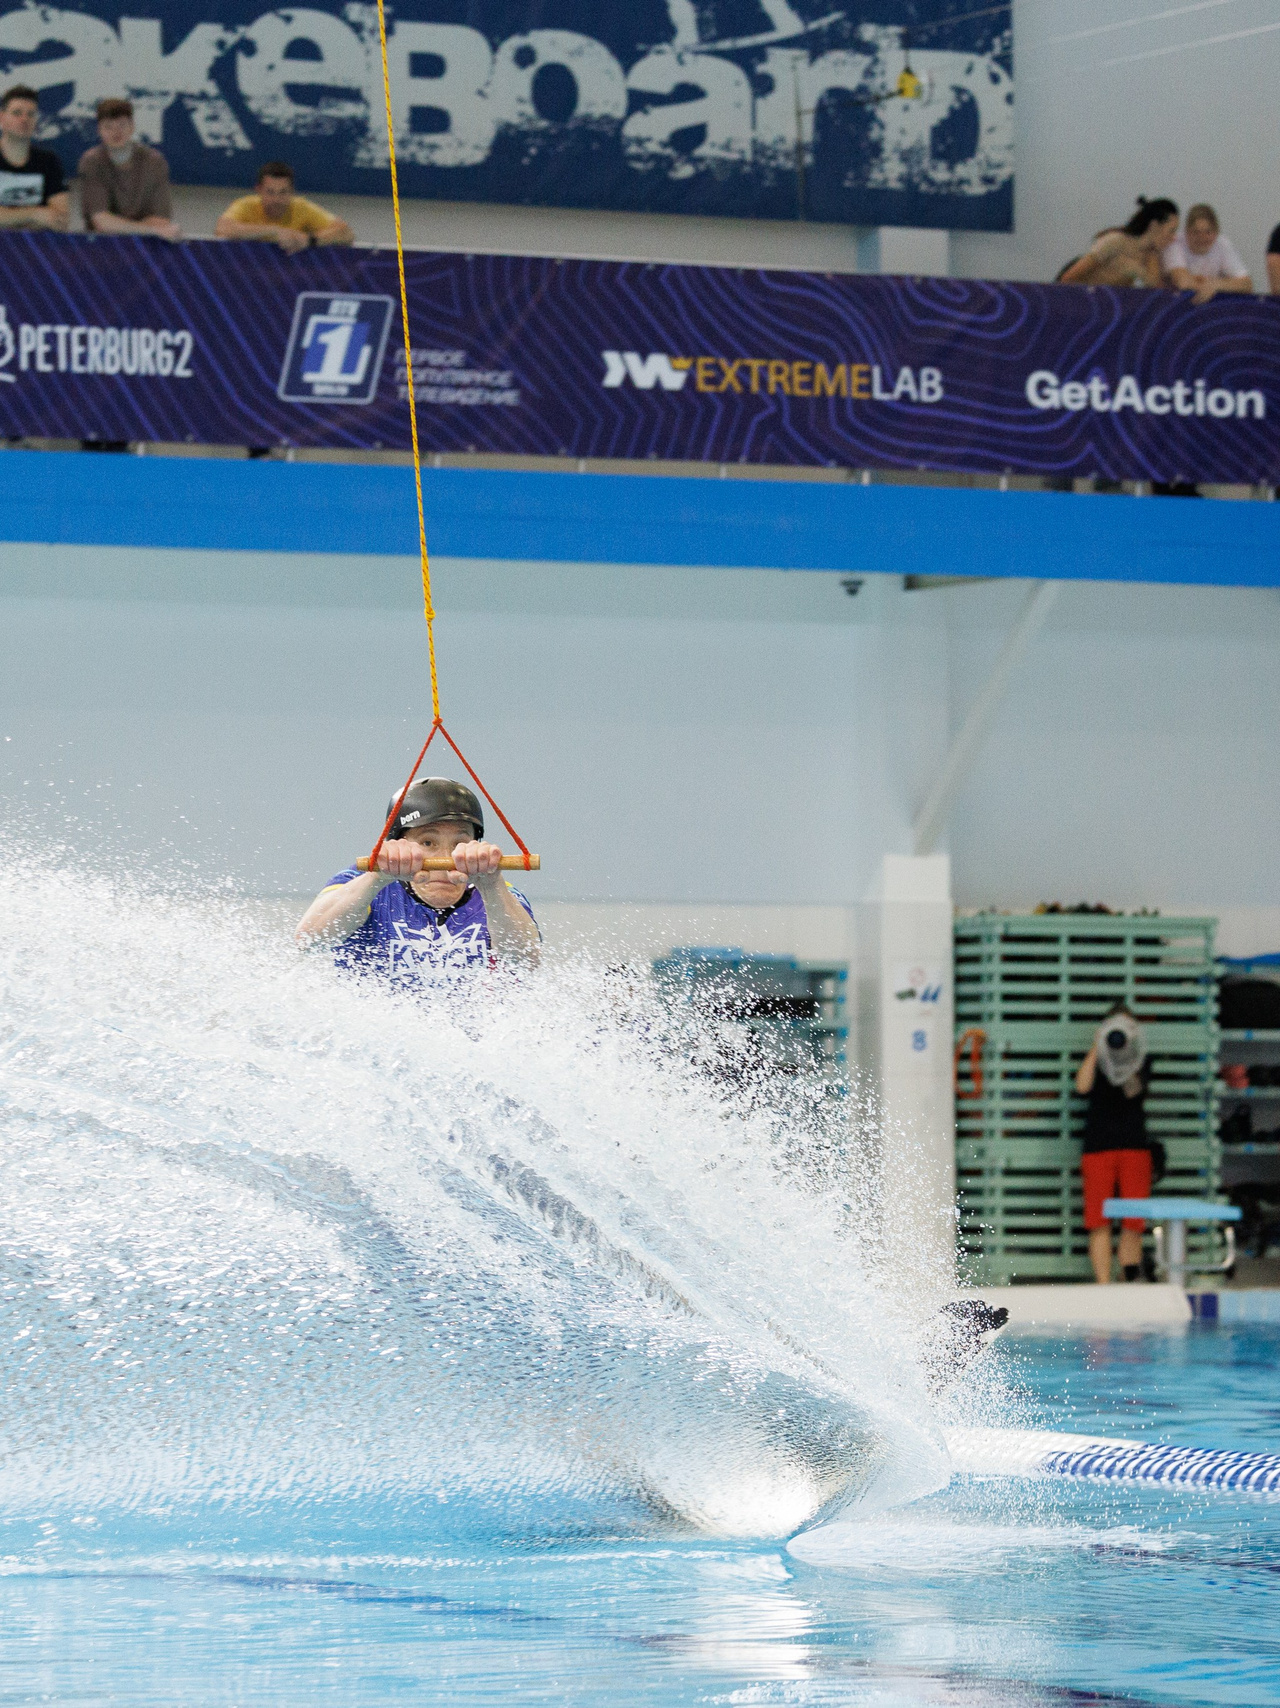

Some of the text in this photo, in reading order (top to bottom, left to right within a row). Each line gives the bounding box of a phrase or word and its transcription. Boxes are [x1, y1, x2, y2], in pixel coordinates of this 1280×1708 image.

[19, 323, 193, 378] PETERBURG2
[695, 356, 943, 402] EXTREMELAB
[1025, 370, 1266, 419] GetAction
